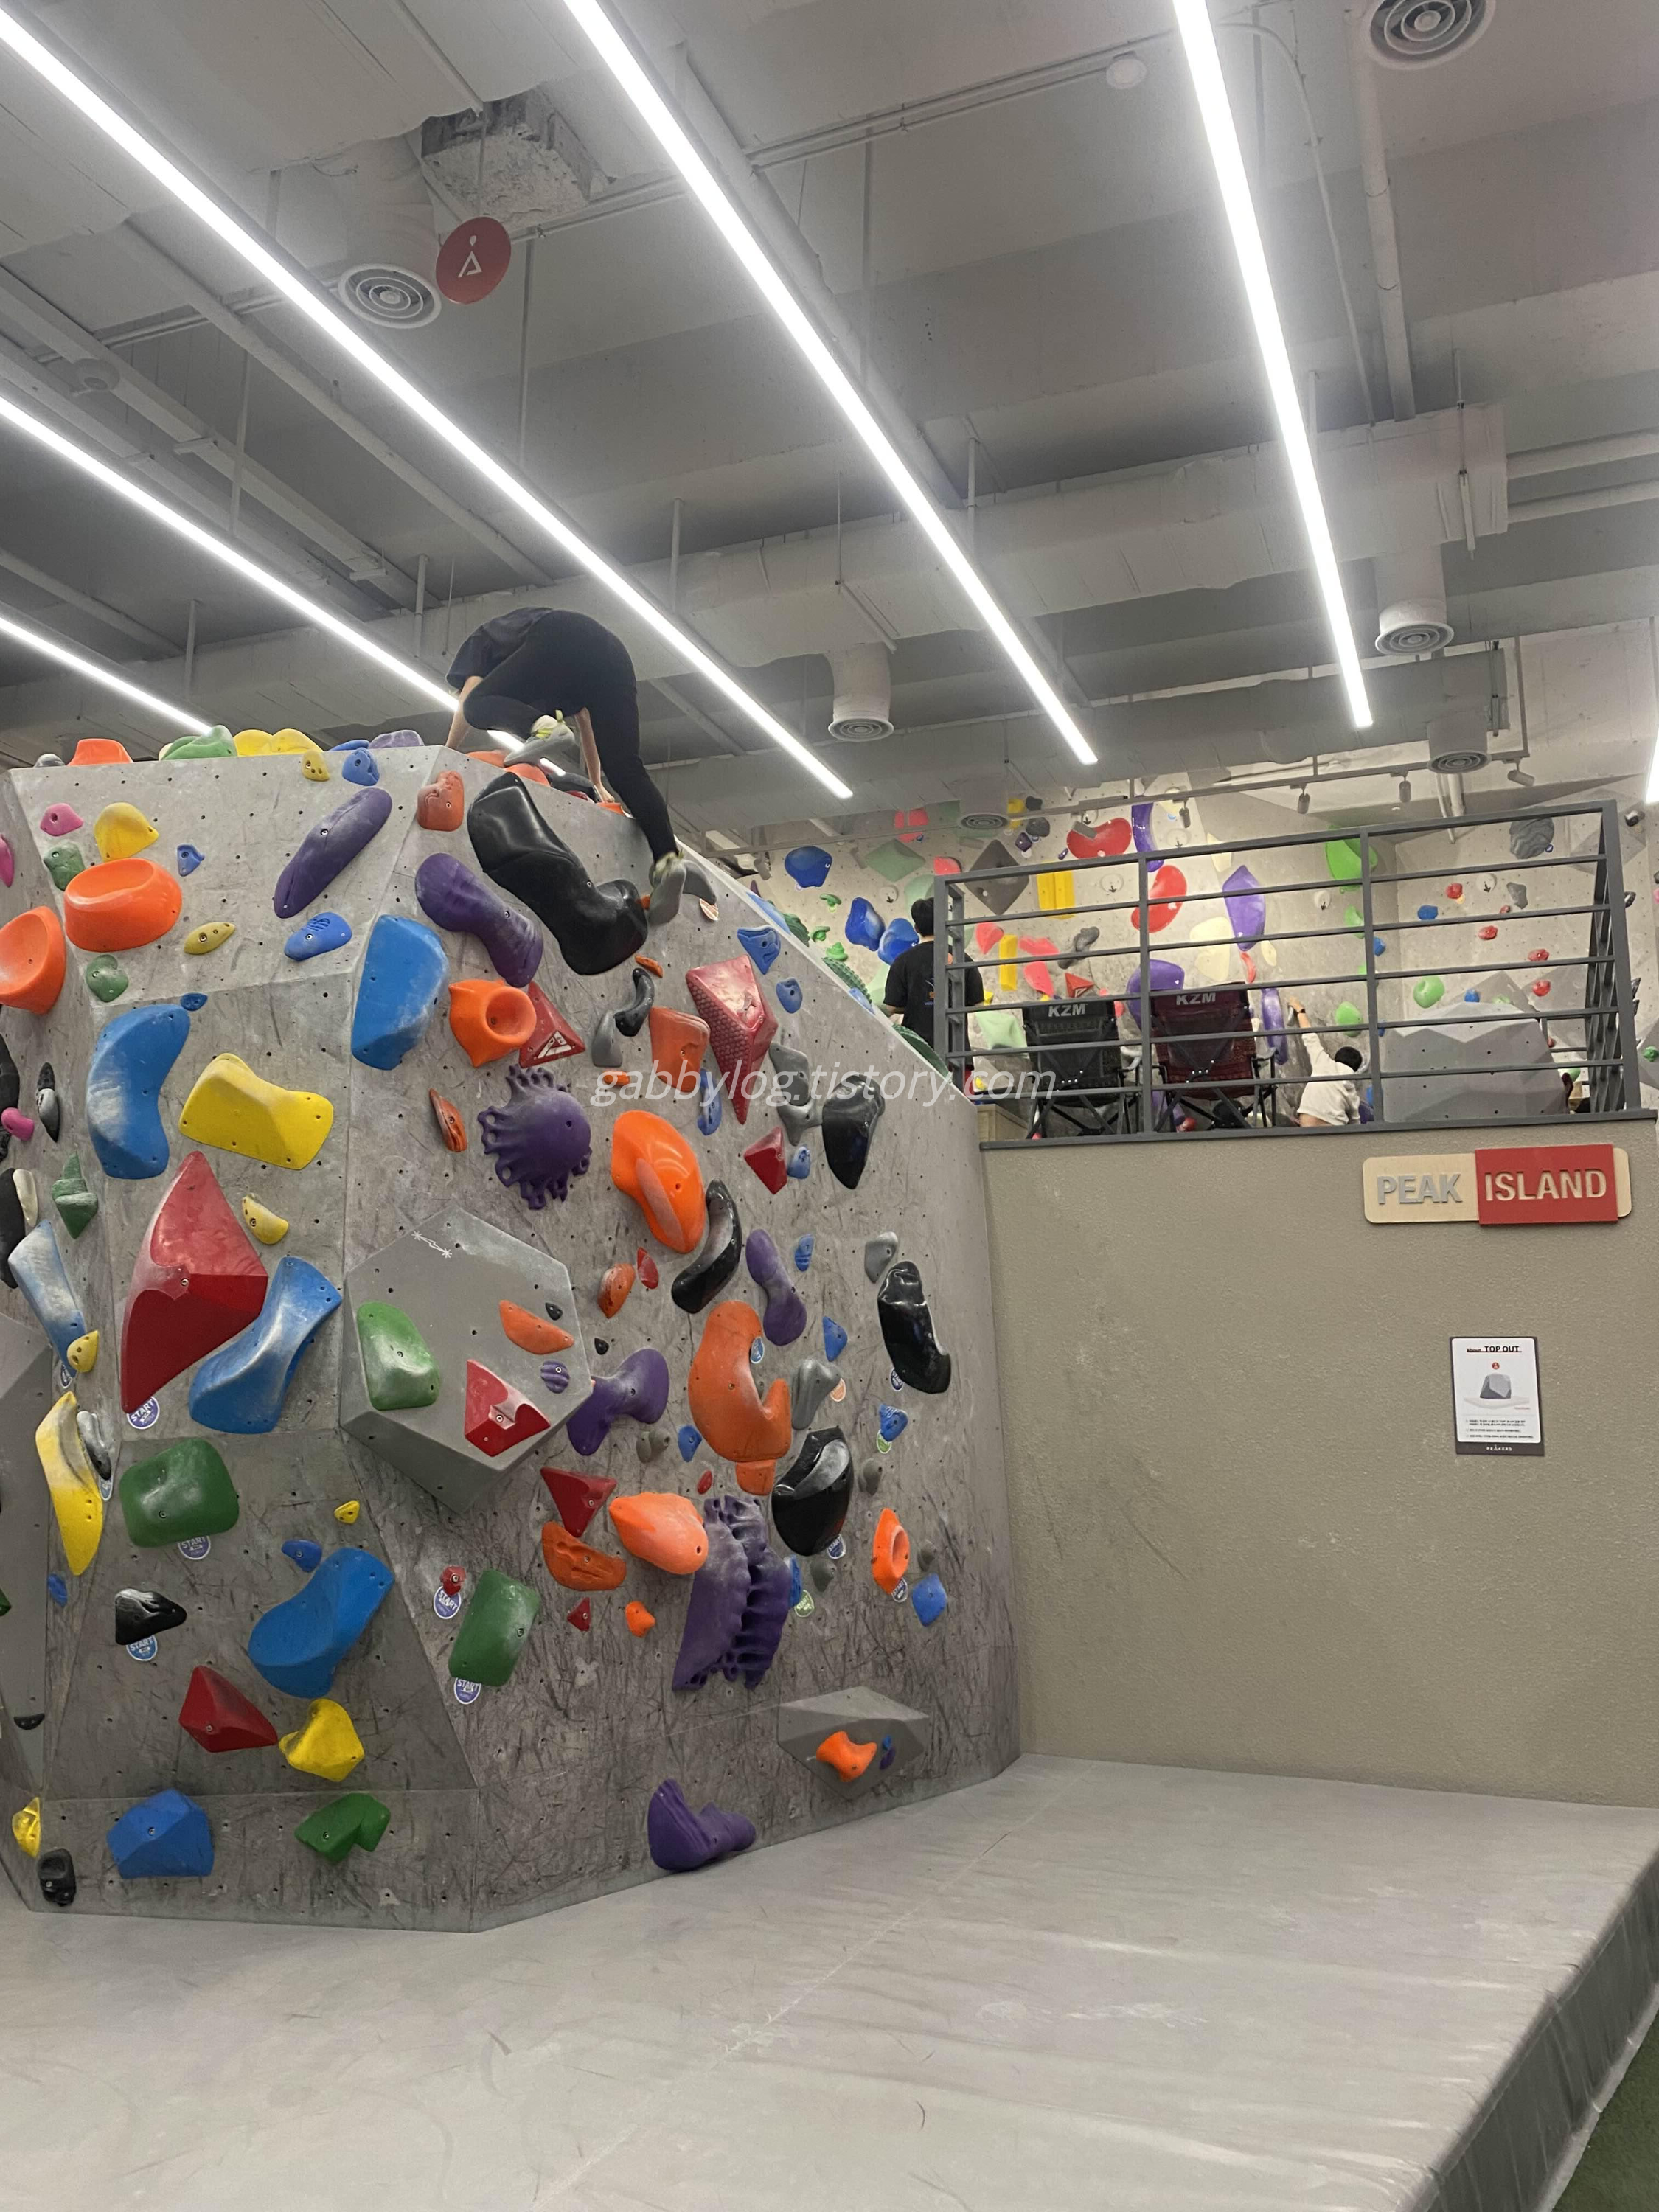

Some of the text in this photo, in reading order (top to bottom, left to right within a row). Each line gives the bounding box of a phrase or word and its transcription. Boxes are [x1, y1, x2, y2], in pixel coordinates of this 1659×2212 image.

[1176, 992, 1217, 1006] KZM
[1048, 1003, 1086, 1018] KZM
[1377, 1169, 1607, 1205] PEAK ISLAND
[130, 1399, 154, 1422] START
[181, 1536, 206, 1548] START
[827, 1537, 841, 1552] START
[438, 1590, 458, 1610] START
[131, 1637, 154, 1651] START
[457, 1679, 479, 1690] START
